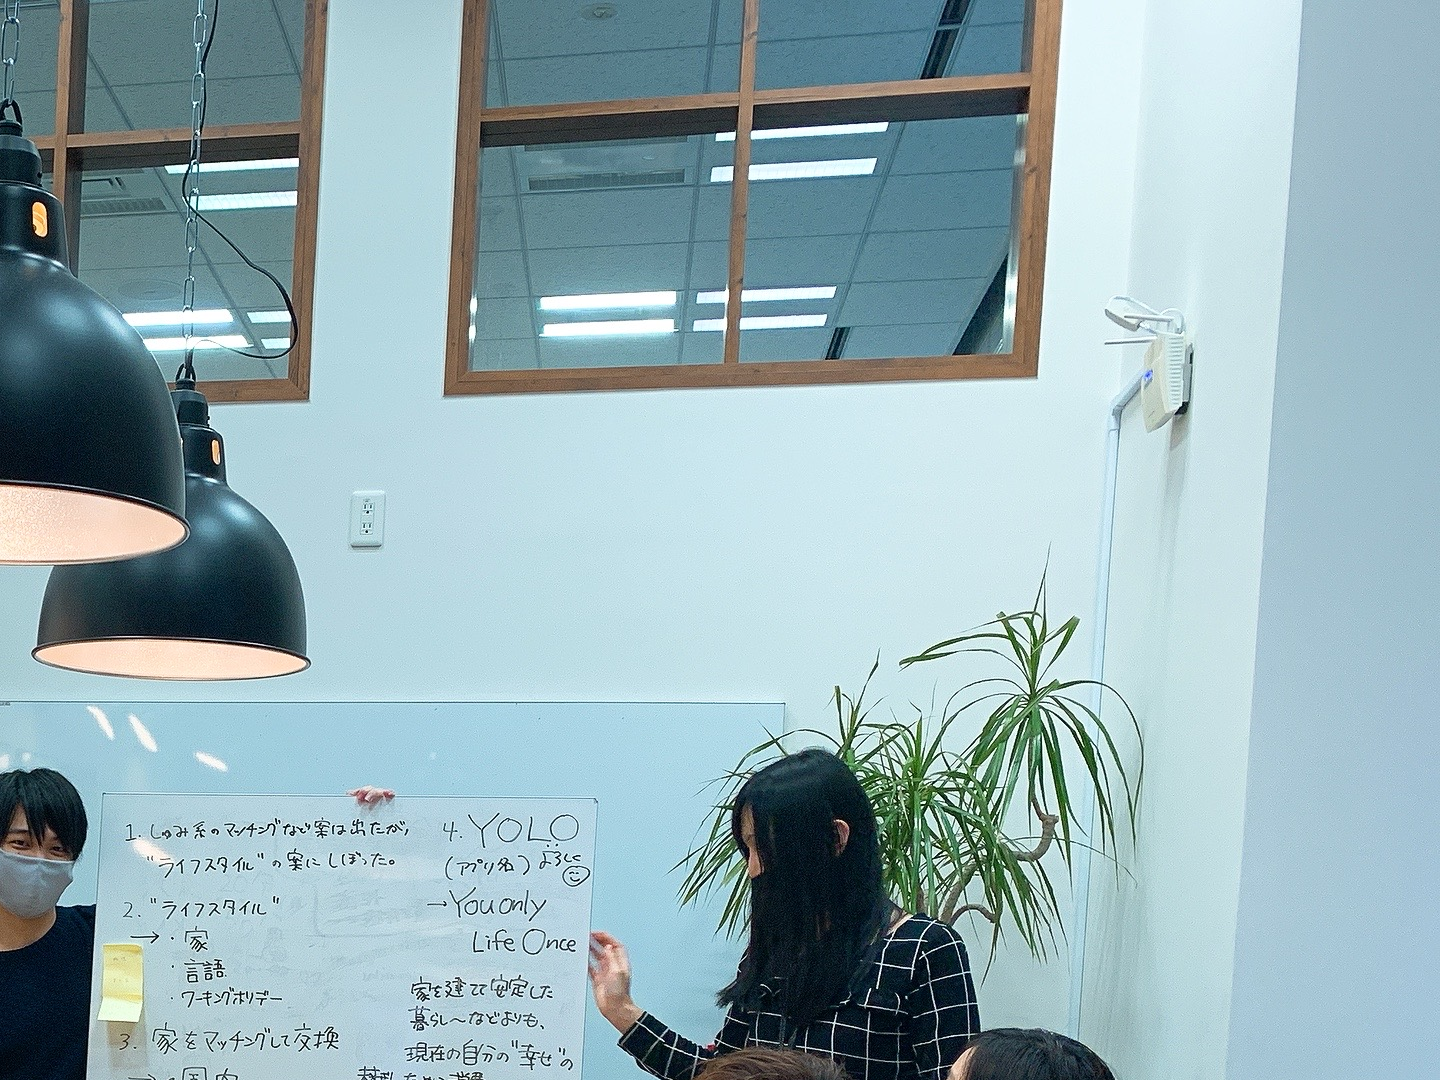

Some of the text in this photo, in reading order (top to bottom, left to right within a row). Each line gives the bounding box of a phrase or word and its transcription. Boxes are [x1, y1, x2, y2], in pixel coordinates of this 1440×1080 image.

[468, 813, 579, 848] YOLO
[449, 887, 546, 921] You only
[473, 929, 576, 955] Life Once
